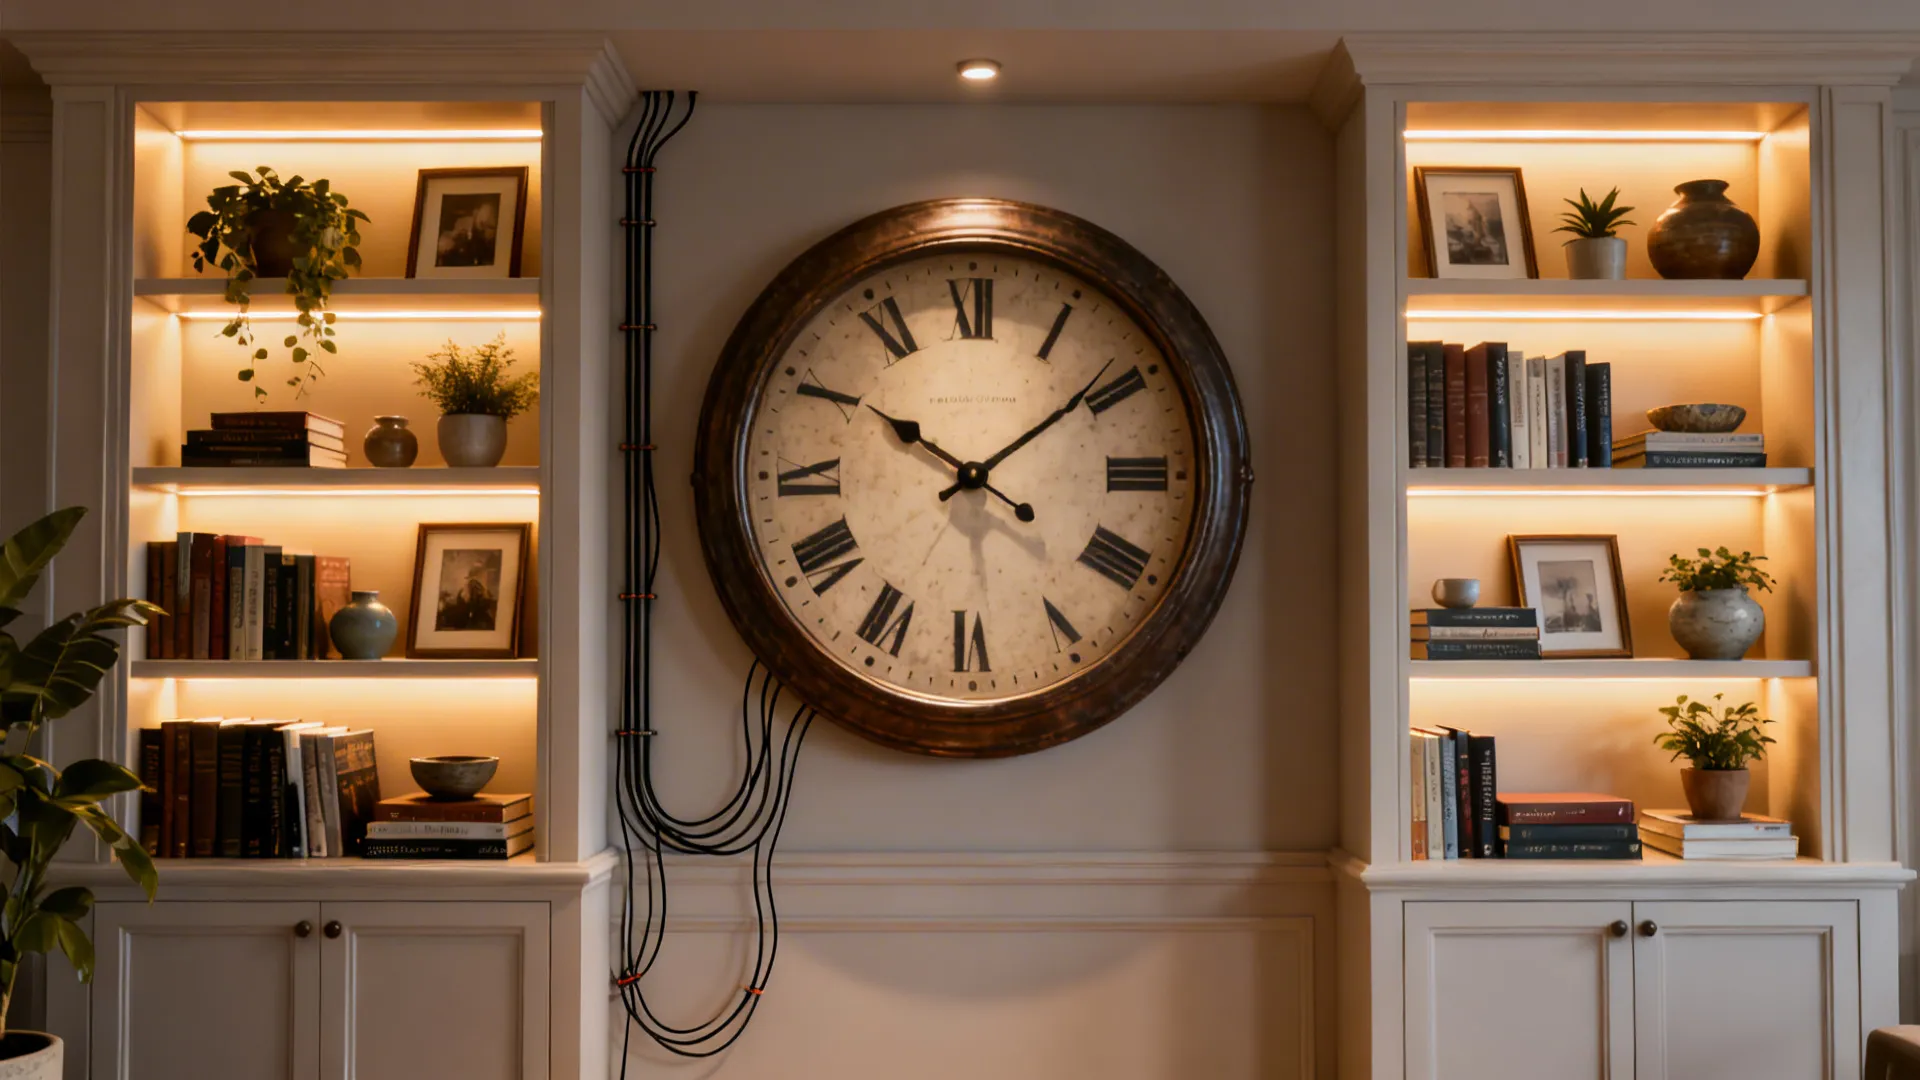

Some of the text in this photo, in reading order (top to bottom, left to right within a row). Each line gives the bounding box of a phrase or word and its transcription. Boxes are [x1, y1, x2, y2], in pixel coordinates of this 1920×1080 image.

[858, 295, 921, 367] XI
[945, 278, 997, 341] XII
[1036, 302, 1073, 363] I
[796, 368, 861, 423] X
[1106, 454, 1168, 493] III
[1042, 596, 1082, 654] V
